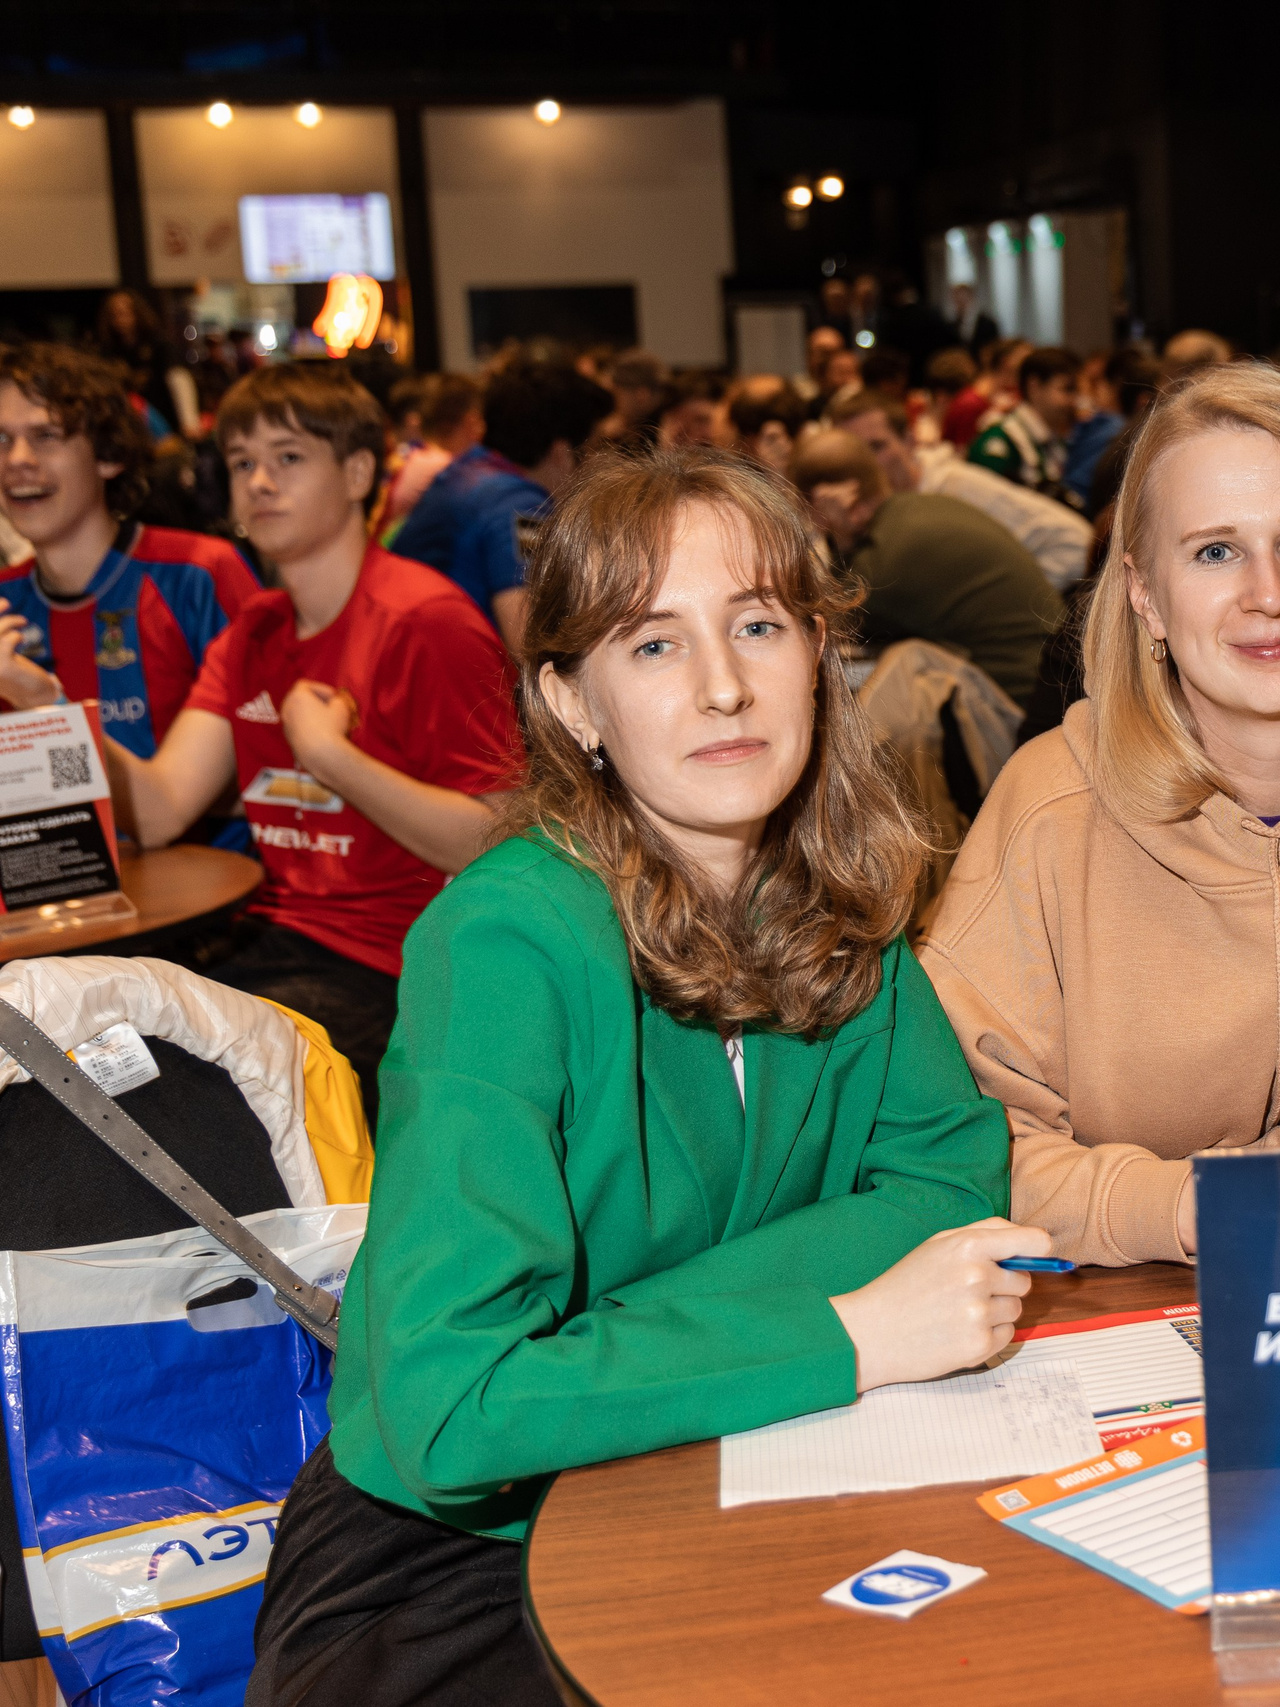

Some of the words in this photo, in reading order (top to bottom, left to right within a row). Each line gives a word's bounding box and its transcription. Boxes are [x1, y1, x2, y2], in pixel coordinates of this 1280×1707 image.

[101, 696, 146, 724] oup
[1162, 1306, 1200, 1316] BOOM
[1055, 1460, 1116, 1489] BETBOOM
